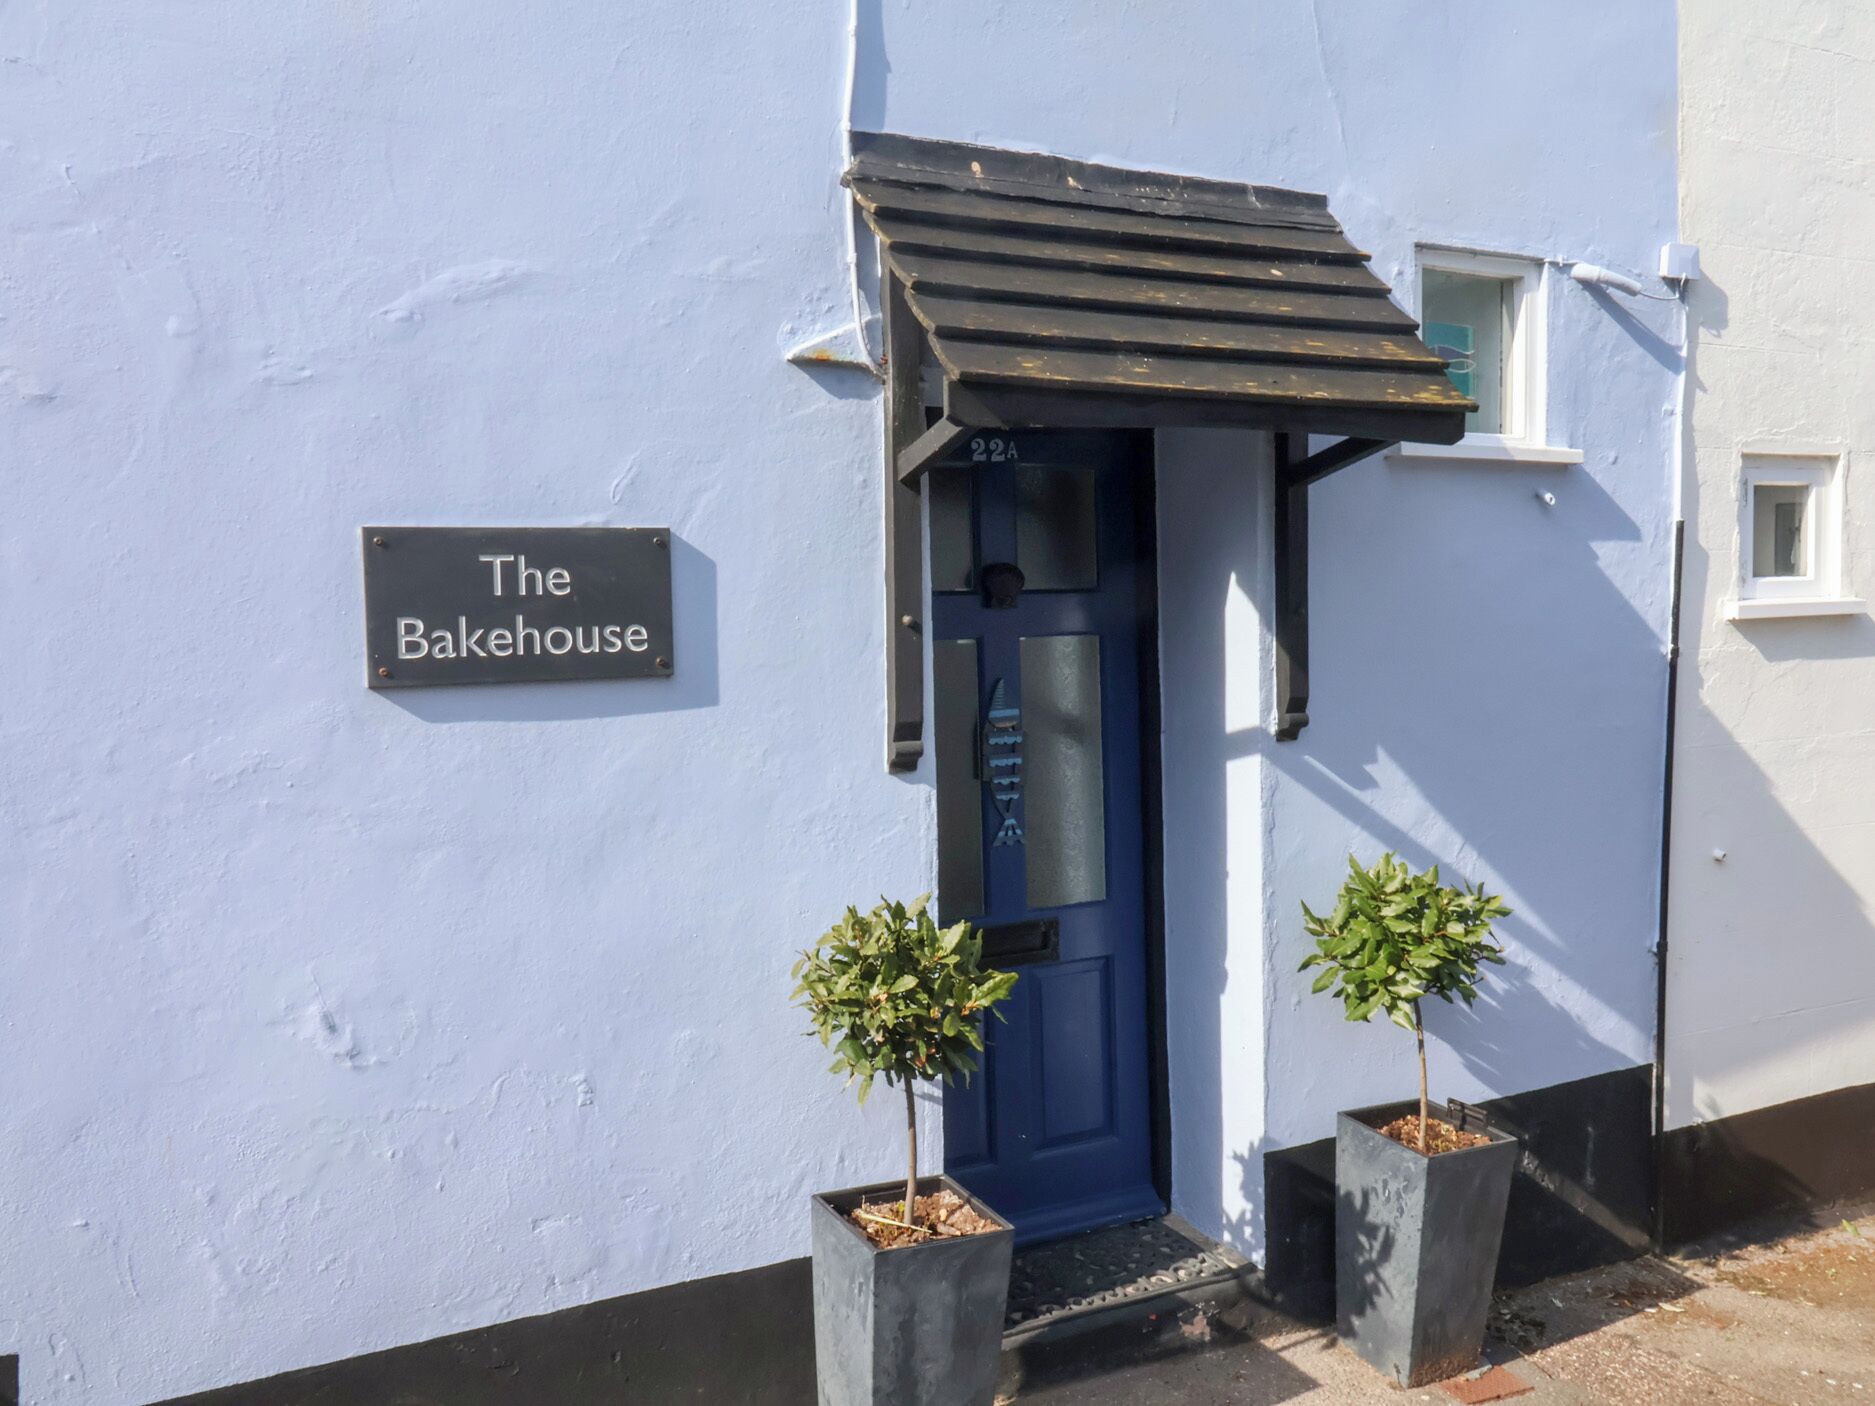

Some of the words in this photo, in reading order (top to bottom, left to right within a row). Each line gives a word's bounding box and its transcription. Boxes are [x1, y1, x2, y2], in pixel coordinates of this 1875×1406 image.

[971, 438, 1018, 462] 22A
[478, 554, 571, 596] The
[397, 614, 648, 660] Bakehouse
